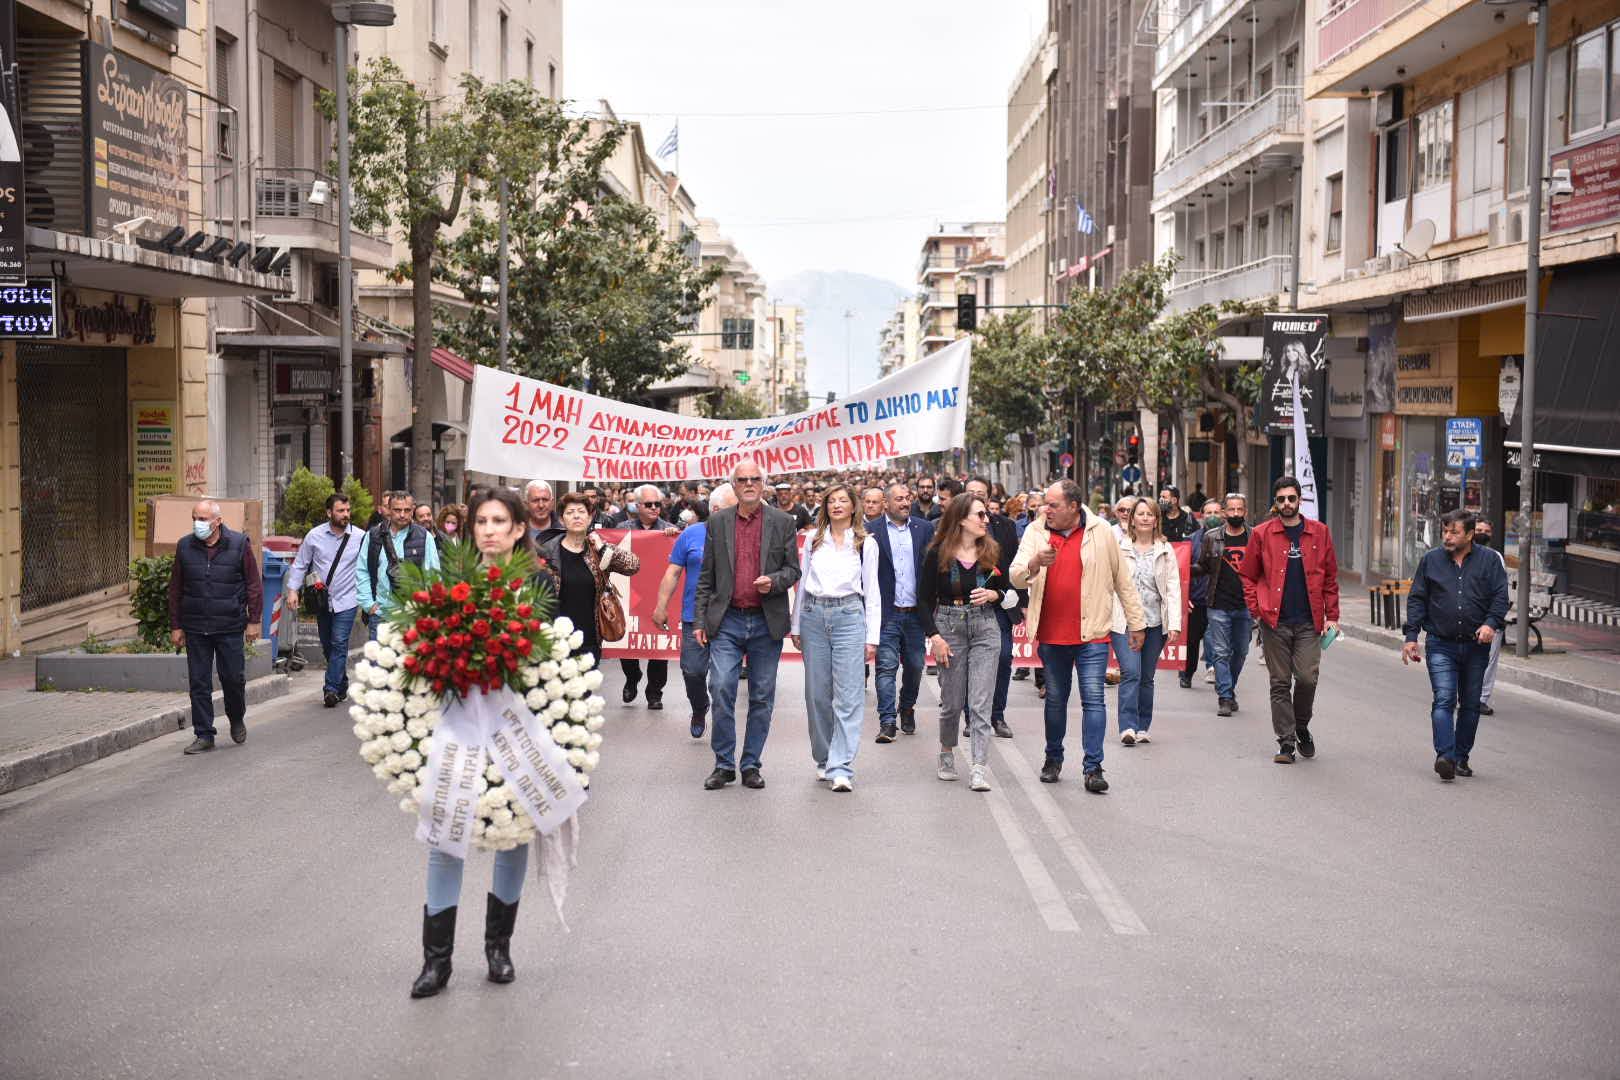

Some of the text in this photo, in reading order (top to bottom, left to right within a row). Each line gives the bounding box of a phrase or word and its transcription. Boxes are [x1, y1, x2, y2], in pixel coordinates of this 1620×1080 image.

[1272, 321, 1317, 332] ROMEO
[502, 414, 570, 451] 2022
[583, 434, 712, 458] ΔΙΕΚΔΙΚΟΥΜΕ
[844, 401, 870, 425] ΤΟ
[875, 392, 921, 421] ΔΙΚΙΟ
[926, 386, 960, 412] ΜΑΣ
[504, 381, 781, 442] 1 ΜΑΗ ΔΥΝΑΜΩΝΟΥΜΕ ΤΟΝ
[582, 429, 901, 481] ΣΥΝΔΙΚΑΤΟ ΟΙΚΟΟΜΩΝ ΠΑΤΡΑΣ
[491, 729, 552, 817] ΚΕΝΤΡΟ ΠΑΤΡΑΣ
[448, 798, 470, 843] ΚΕΝΤΡΟ
